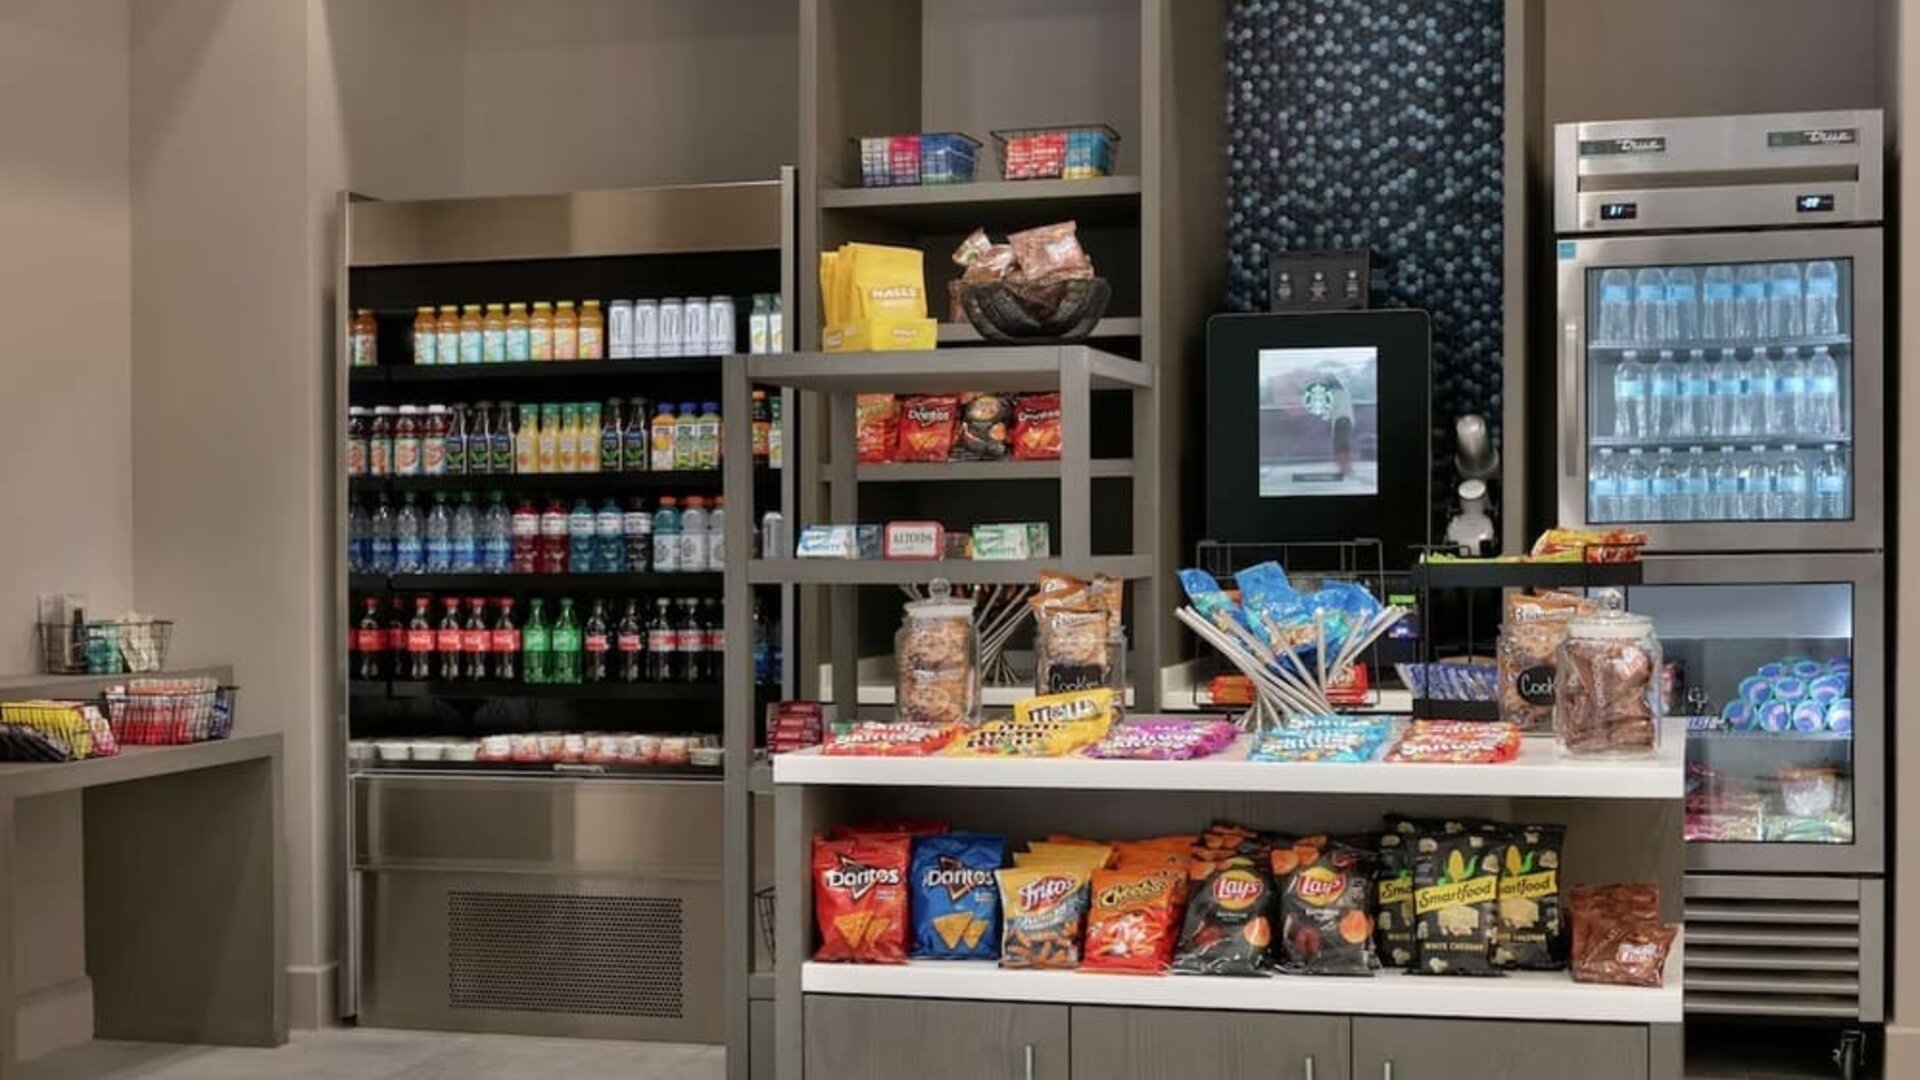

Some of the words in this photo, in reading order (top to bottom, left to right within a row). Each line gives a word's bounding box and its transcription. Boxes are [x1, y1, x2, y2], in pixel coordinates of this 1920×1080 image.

[871, 287, 918, 299] HALLS
[828, 868, 900, 888] Doritos
[922, 869, 994, 887] Doritos
[1019, 879, 1074, 911] Fritos
[1418, 882, 1492, 909] Smartfood
